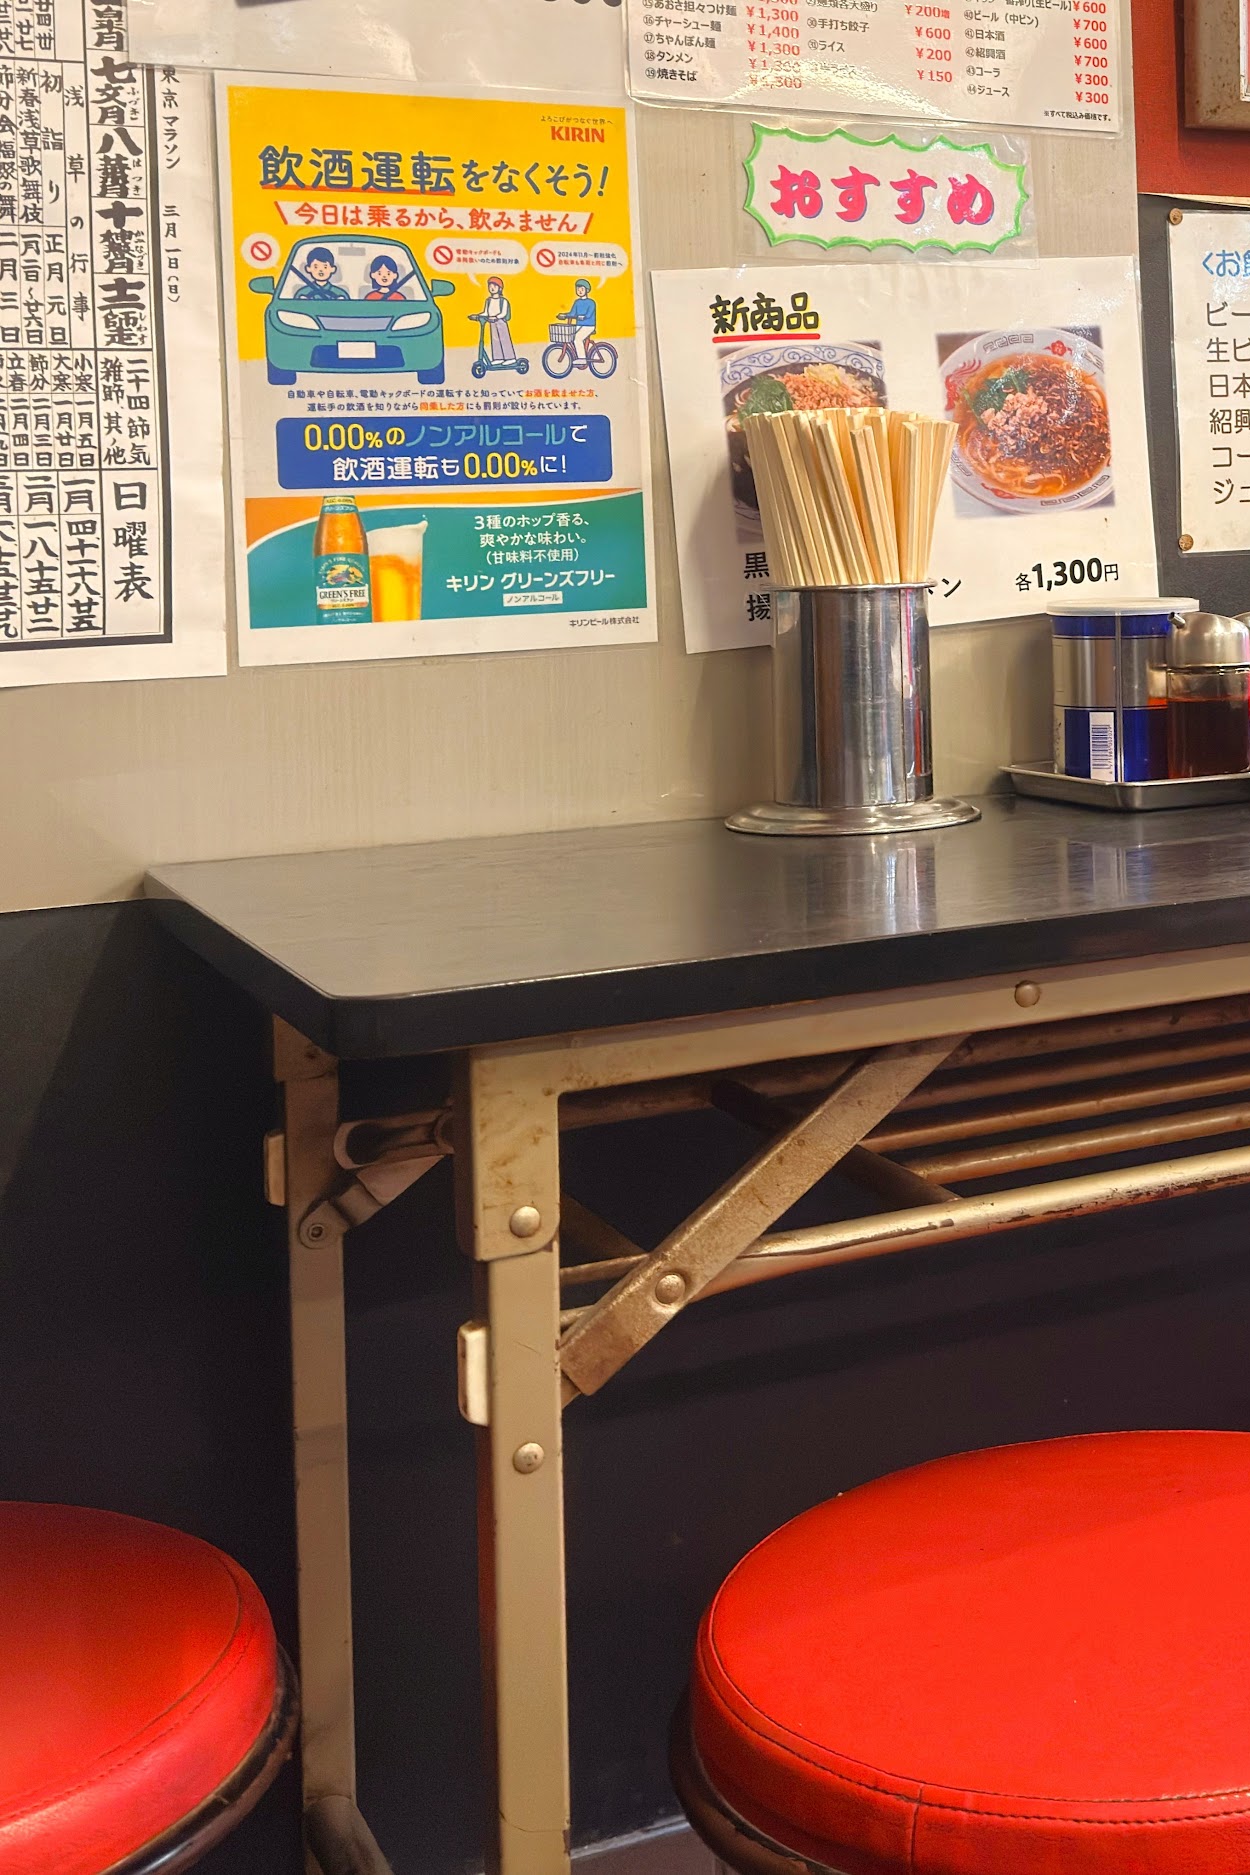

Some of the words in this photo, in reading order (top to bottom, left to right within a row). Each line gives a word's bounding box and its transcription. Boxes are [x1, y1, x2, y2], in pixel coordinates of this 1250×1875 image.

[551, 126, 605, 143] KIRIN
[769, 164, 996, 227] おすすめ
[294, 203, 578, 234] 今日は乗るから、飲みません
[709, 291, 820, 335] 新商品
[113, 481, 155, 602] 日曜表
[446, 575, 494, 592] キリン
[501, 571, 615, 590] グリーンズフリー
[1014, 556, 1120, 593] 各1,300円
